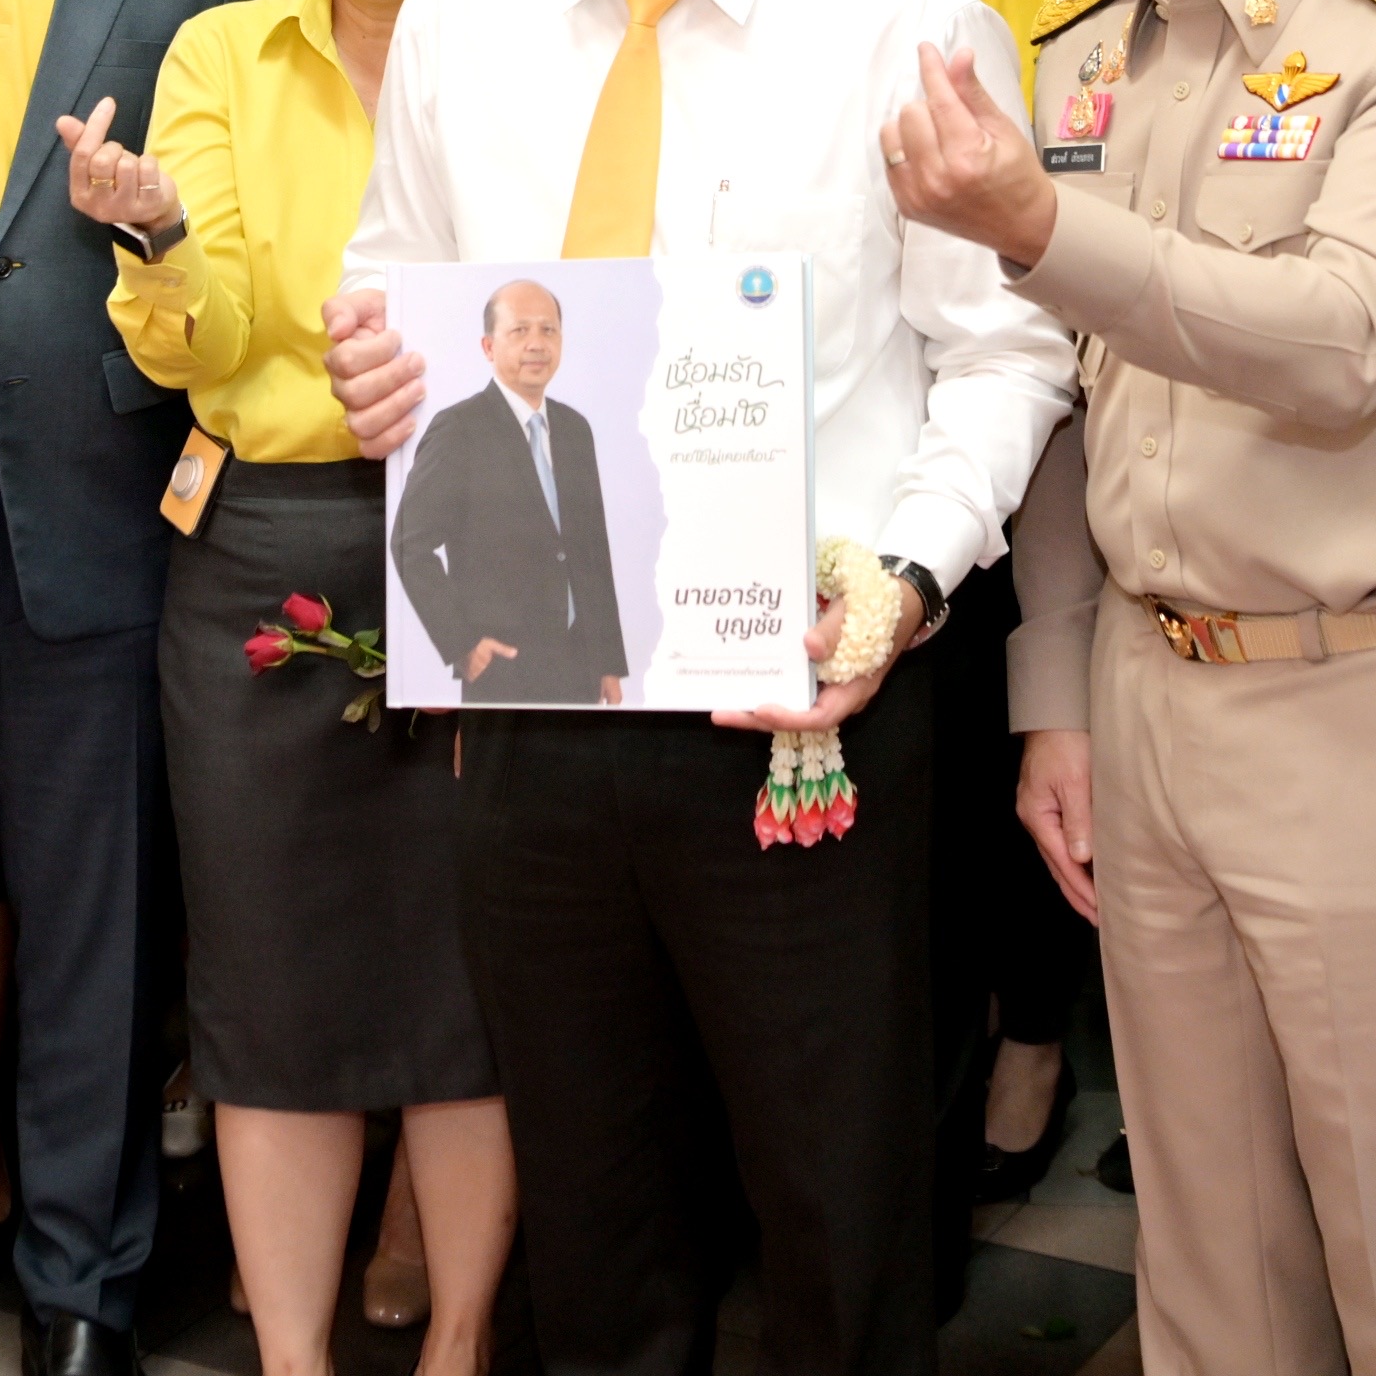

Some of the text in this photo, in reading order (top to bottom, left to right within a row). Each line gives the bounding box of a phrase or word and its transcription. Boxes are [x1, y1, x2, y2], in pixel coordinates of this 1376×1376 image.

[665, 347, 785, 390] เชื่อมรัก
[674, 391, 769, 435] เชื่อมใจ
[674, 581, 783, 610] นายอารัญ
[715, 611, 783, 644] บุญชัย
